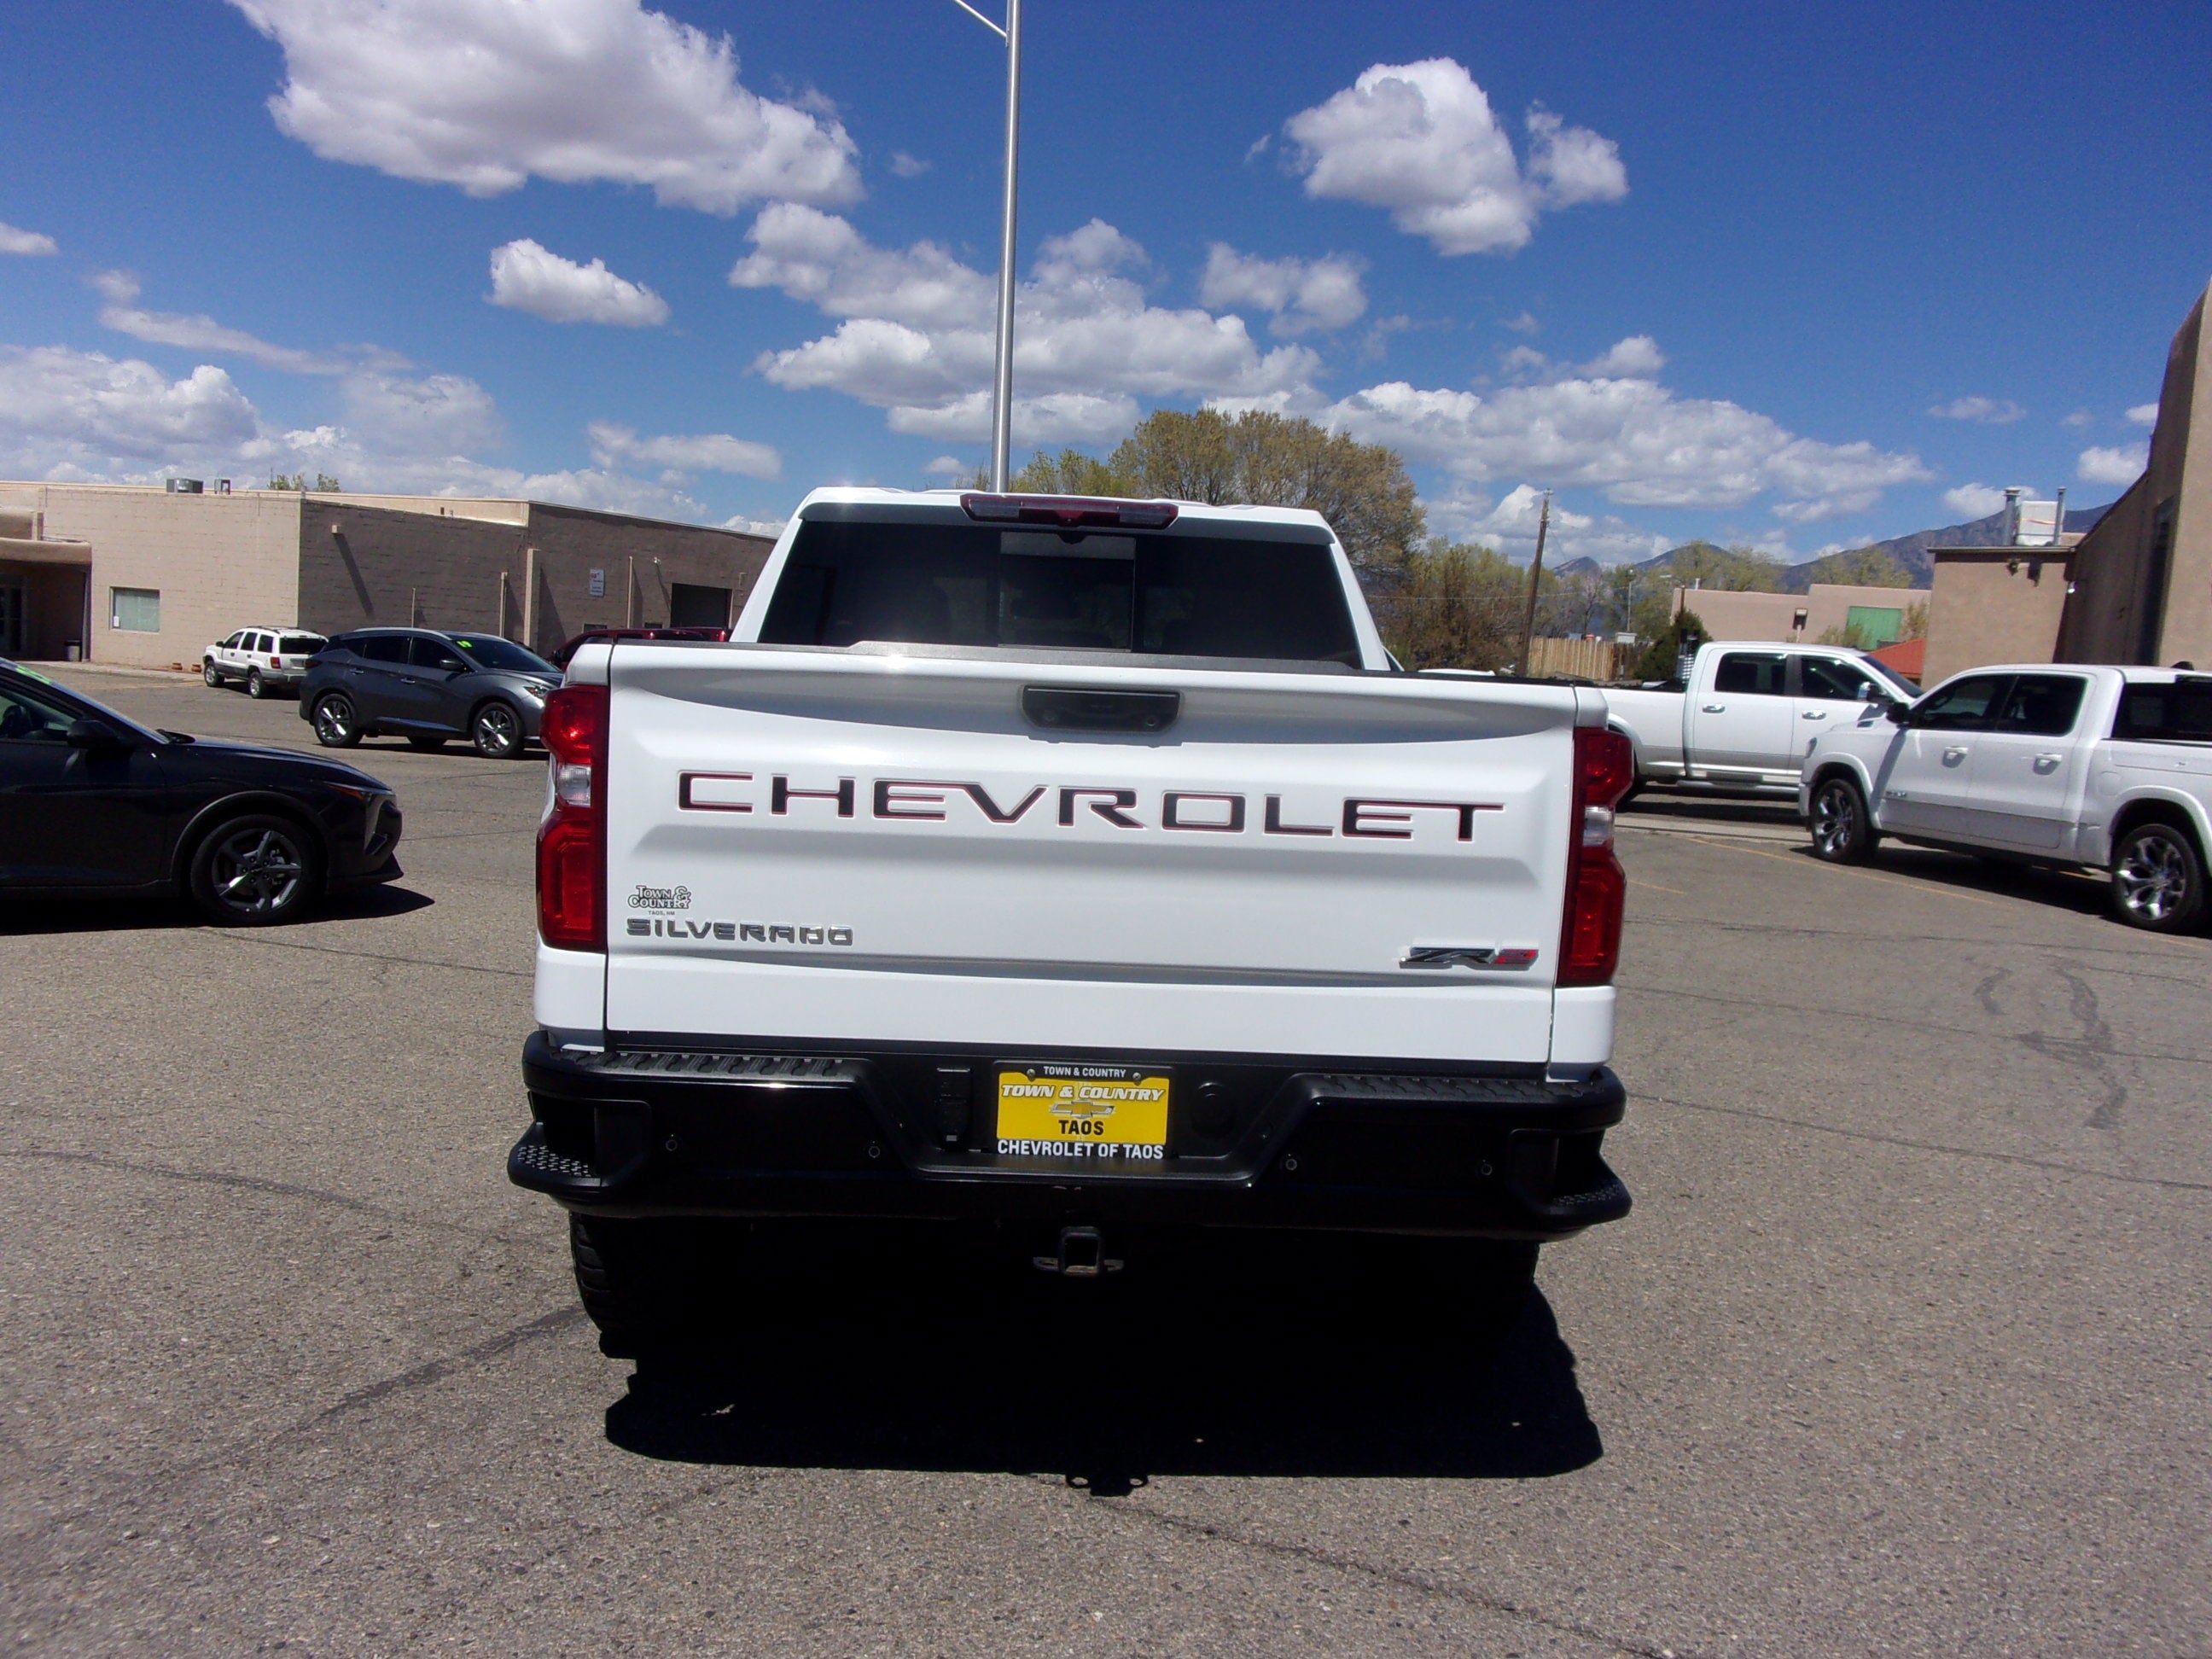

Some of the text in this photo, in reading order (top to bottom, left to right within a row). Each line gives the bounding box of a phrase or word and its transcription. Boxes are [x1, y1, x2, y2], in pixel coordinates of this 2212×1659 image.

[677, 770, 1505, 842] CHEVROLET
[636, 885, 692, 901] TOWN &
[628, 894, 691, 909] COUNTRY
[626, 917, 853, 946] SILVERADO
[1043, 1066, 1126, 1078] TOWN & COUNTRY
[1002, 1084, 1164, 1100] TOWN & COUNTRY
[1058, 1120, 1104, 1136] TAOS
[997, 1139, 1164, 1160] CHEVROLET OF TAOS
